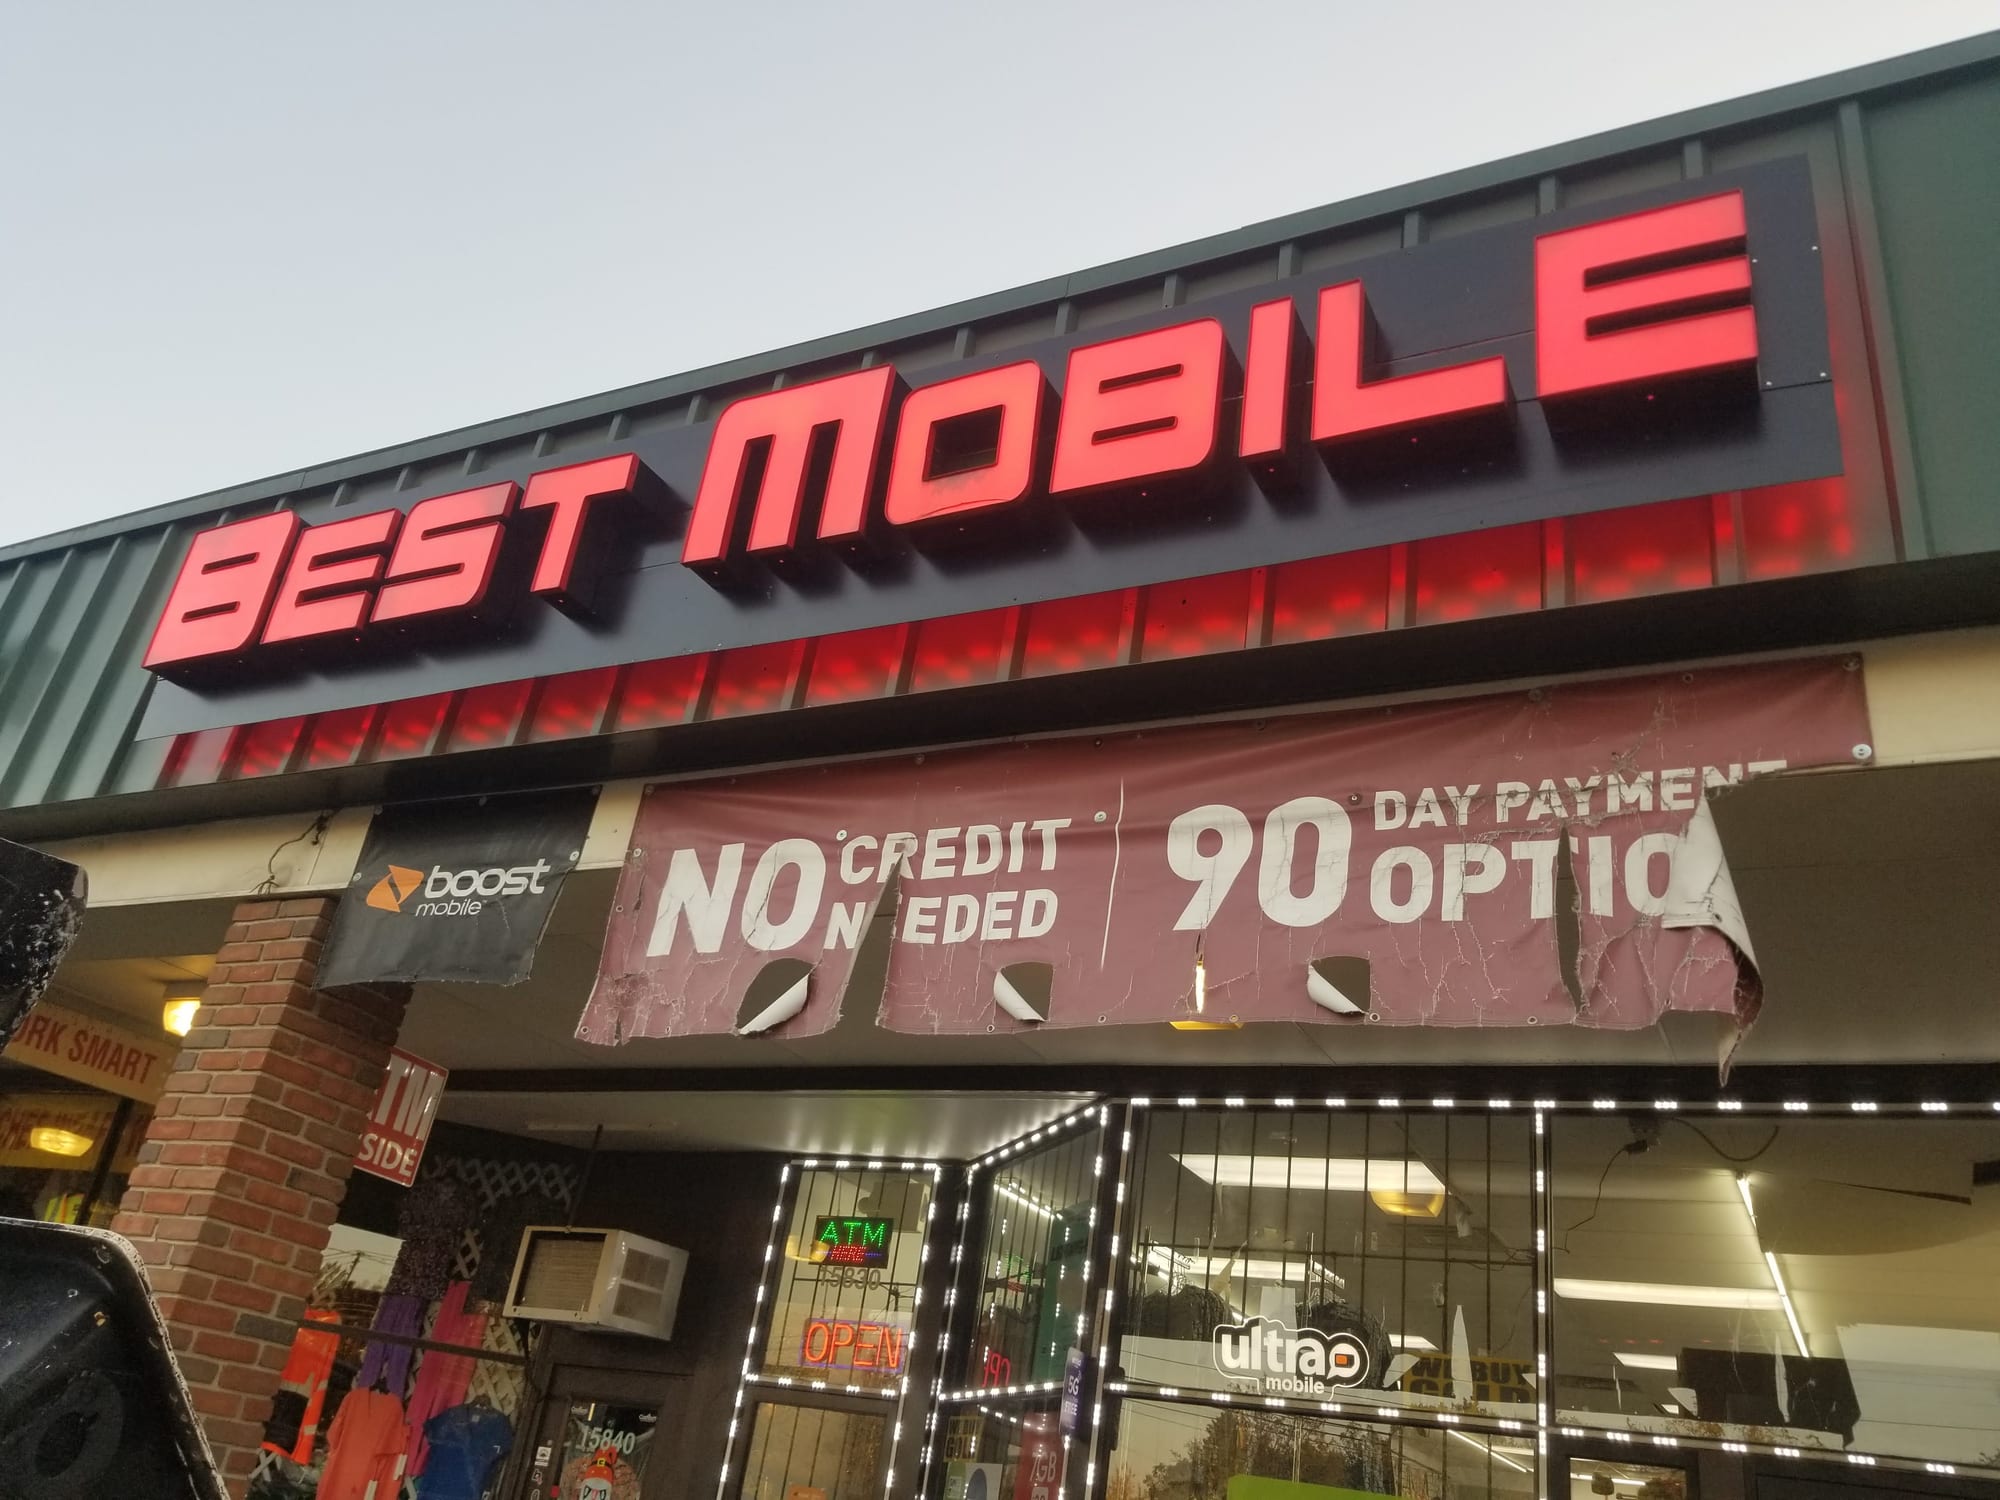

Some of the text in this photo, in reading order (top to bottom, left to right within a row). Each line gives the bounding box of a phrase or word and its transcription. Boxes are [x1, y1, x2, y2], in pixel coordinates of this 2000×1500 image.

[141, 187, 1759, 669] BEST MOBILE
[1373, 783, 1481, 831] DAY
[839, 817, 1073, 885] CREDIT
[1166, 796, 1353, 931] 90
[424, 858, 551, 899] boost
[646, 838, 827, 958] NO
[1369, 832, 1688, 924] OPTIO
[415, 898, 482, 917] mobile
[823, 888, 1059, 950] NEDED
[68, 1029, 158, 1084] SMART
[366, 1053, 446, 1142] TM
[358, 1132, 418, 1177] SIDE
[819, 1220, 887, 1248] ATM
[820, 1265, 881, 1290] 15830
[804, 1322, 902, 1368] OPEN
[1221, 1325, 1326, 1376] ultra
[1068, 1375, 1080, 1396] 5G
[1265, 1376, 1325, 1394] mobile
[576, 1425, 636, 1455] 15840
